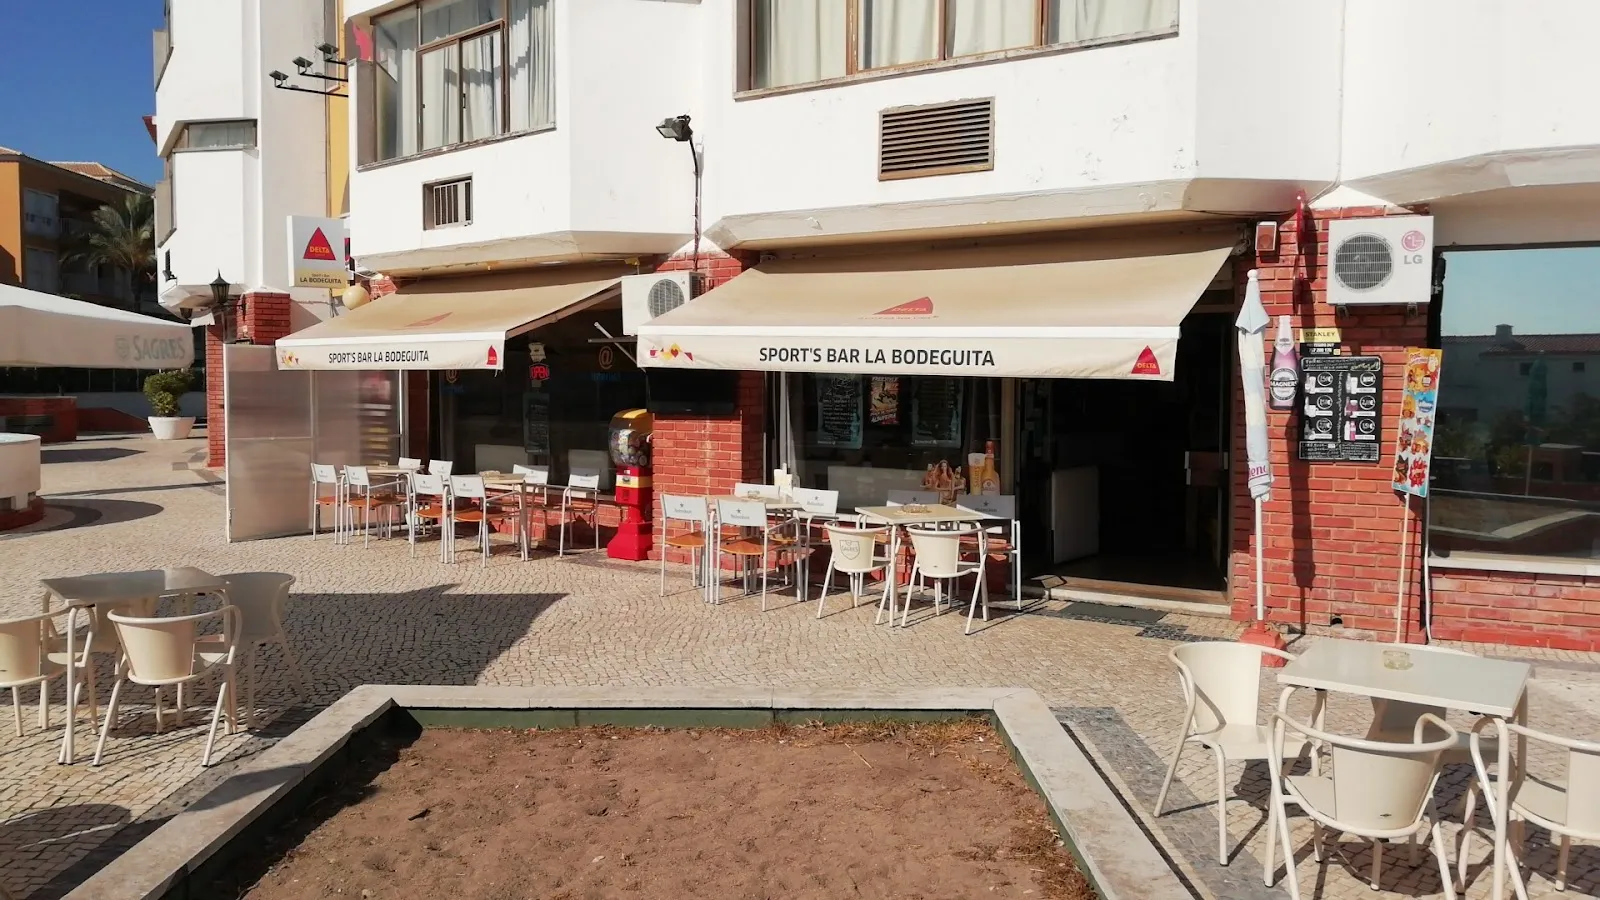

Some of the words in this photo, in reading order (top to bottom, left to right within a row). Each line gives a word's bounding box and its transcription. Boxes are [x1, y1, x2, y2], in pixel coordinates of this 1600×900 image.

[1403, 254, 1423, 265] LG
[133, 335, 185, 361] SAGRES
[328, 351, 356, 364] SPORT'S
[357, 351, 373, 363] BAR
[374, 351, 384, 362] LA
[385, 350, 429, 362] BODEGUITA
[759, 347, 822, 363] SPORT'S
[827, 348, 859, 364] BAR
[865, 349, 886, 364] LA
[892, 349, 995, 367] BODEGUITA
